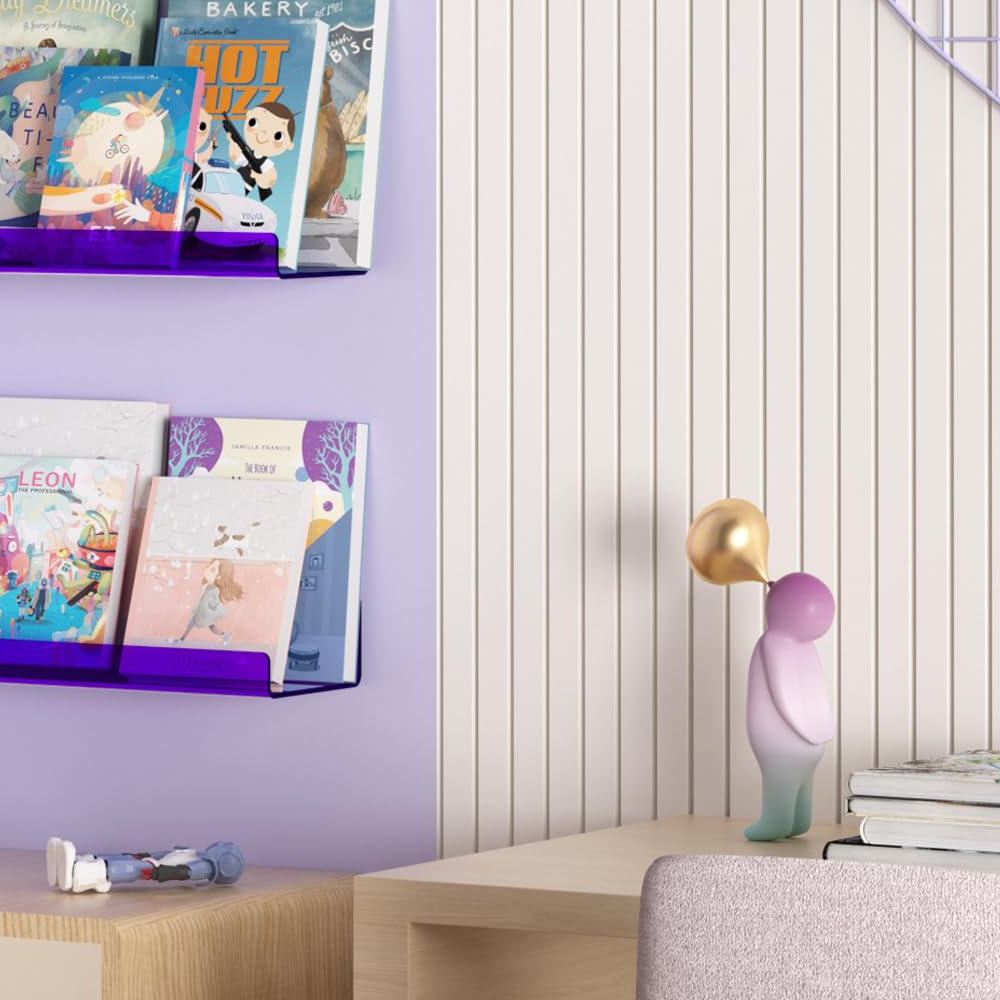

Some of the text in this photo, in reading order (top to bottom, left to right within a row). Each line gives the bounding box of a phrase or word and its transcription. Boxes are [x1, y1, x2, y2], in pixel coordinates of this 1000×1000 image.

[206, 0, 309, 18] BAKERY
[185, 45, 289, 86] HOT
[9, 102, 57, 119] BEA
[18, 470, 77, 489] LEON
